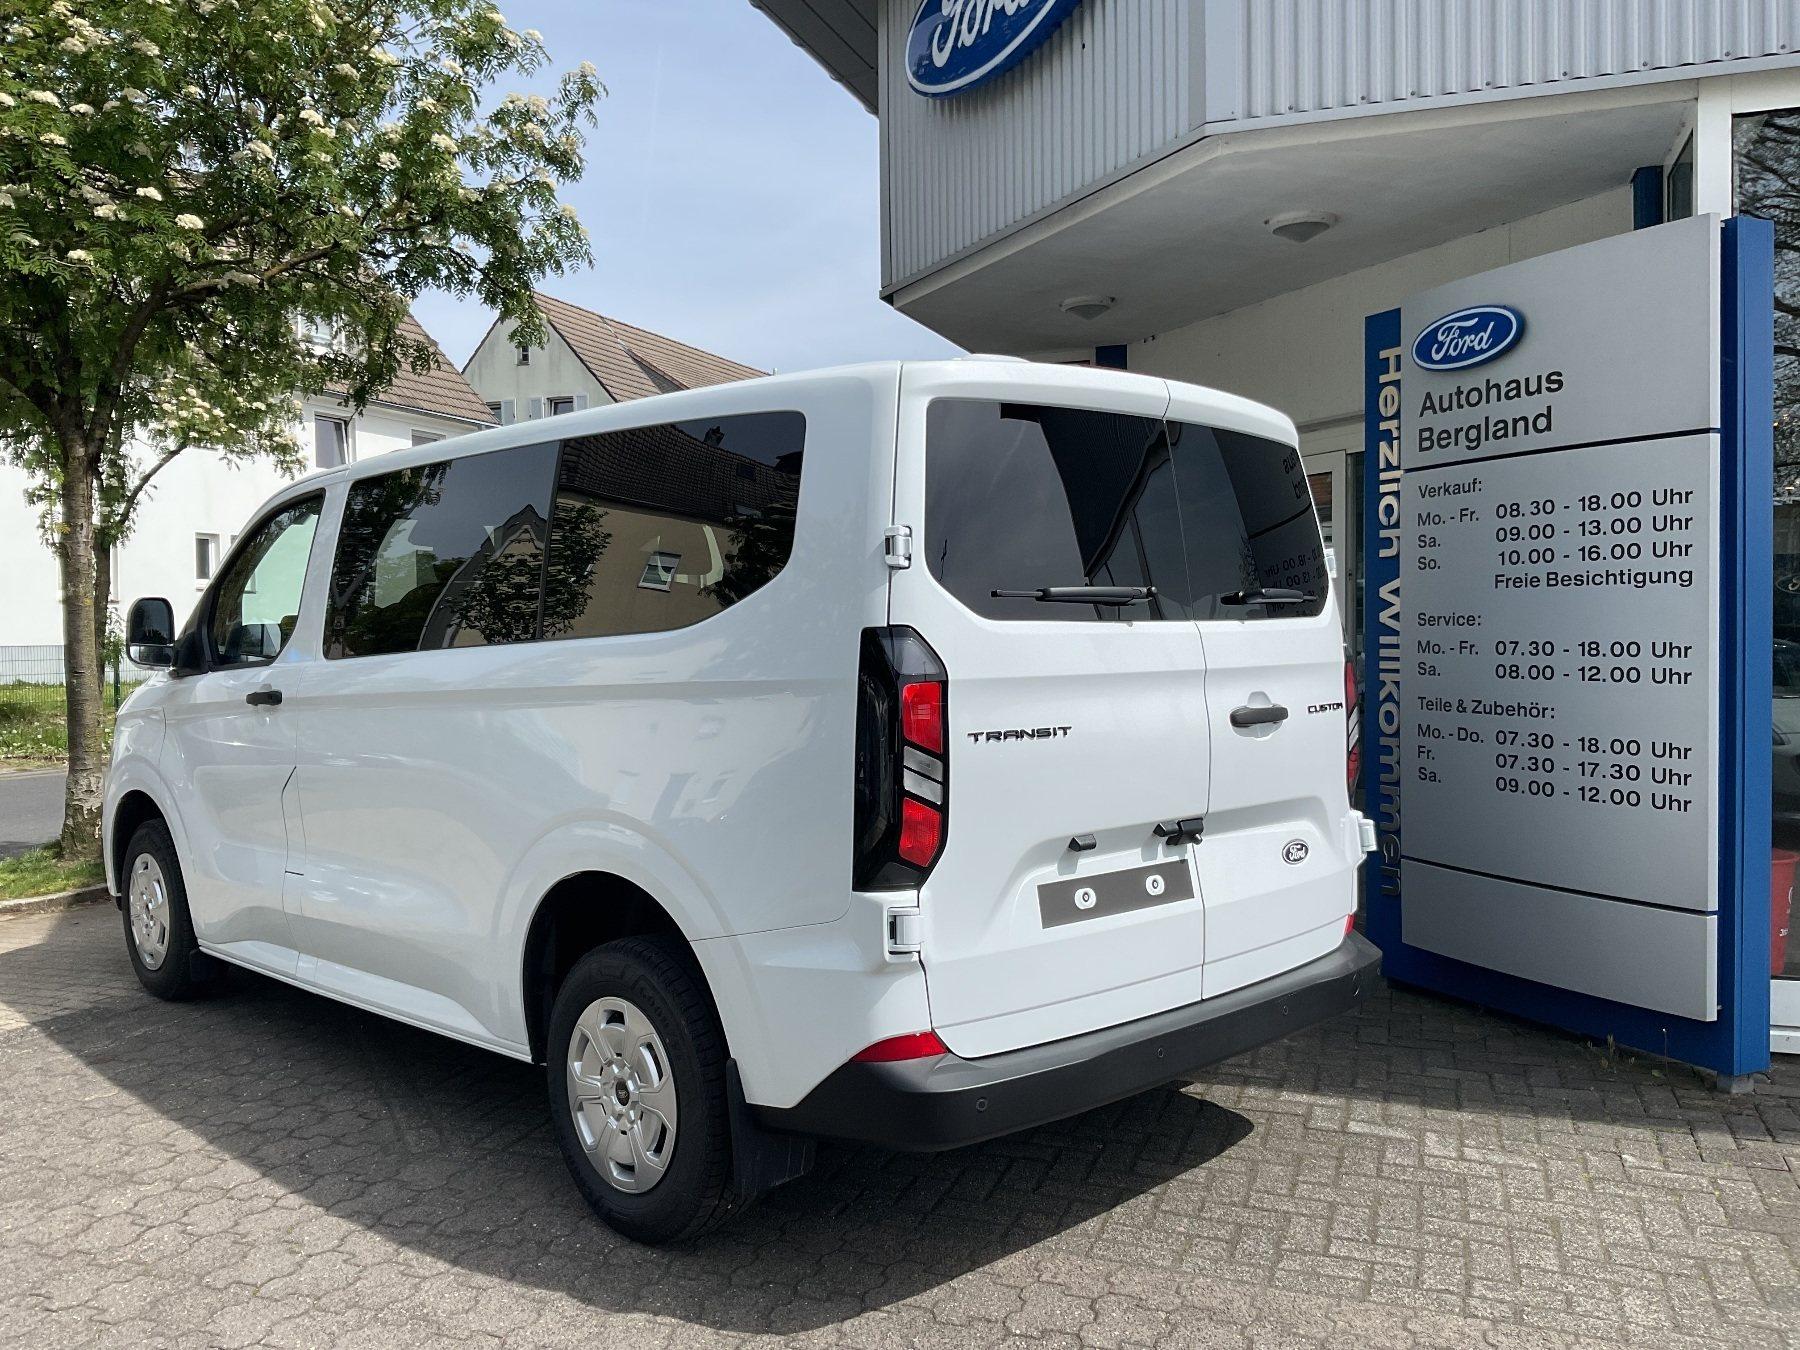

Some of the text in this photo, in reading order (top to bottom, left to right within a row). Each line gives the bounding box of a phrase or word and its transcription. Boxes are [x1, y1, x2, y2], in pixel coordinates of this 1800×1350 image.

[1431, 317, 1494, 361] Ford
[1419, 371, 1564, 417] Autohaus
[1418, 406, 1552, 452] Bergland
[1418, 478, 1481, 498] Verkauf:
[1418, 512, 1445, 526] Mo.
[1460, 508, 1479, 522] Fr.
[1496, 499, 1555, 519] 08.30
[1578, 491, 1641, 511] 18.00
[1653, 488, 1694, 506] Uhr
[1418, 534, 1440, 548] Sa.
[1496, 524, 1555, 542] 09.00
[1577, 517, 1641, 536] 13.00
[1653, 515, 1693, 532] Uhr
[1418, 556, 1440, 570] So.
[1498, 548, 1554, 566] 10.00
[1578, 543, 1641, 561] 16.00
[1653, 541, 1693, 558] Uhr
[1495, 568, 1692, 589] Freie Besichtigung
[1379, 346, 1404, 896] Herzlich Willkommen
[1418, 612, 1481, 626] Service:
[1418, 640, 1445, 654] Mo.
[1459, 641, 1478, 655] Fr.
[1495, 641, 1554, 656] 07.30
[1578, 641, 1641, 657] 18.00
[1652, 642, 1692, 658] Uhr
[1418, 662, 1440, 676] Sa.
[1495, 664, 1554, 680] 08.00
[1577, 666, 1640, 685] 12.00
[1652, 668, 1692, 684] Uhr
[1308, 702, 1343, 713] CUSTOM
[1418, 696, 1554, 720] Teile & Zubehör:
[967, 726, 1072, 744] TRANSIT
[1418, 724, 1446, 739] Mo.
[1457, 727, 1484, 743] Do.
[1496, 730, 1554, 751] 07.30
[1576, 737, 1640, 756] 18.00
[1652, 742, 1692, 759] Uhr
[1418, 745, 1435, 760] Fr.
[1496, 753, 1554, 775] 07.30
[1578, 761, 1640, 782] 17.30
[1652, 767, 1692, 786] Uhr
[1418, 767, 1441, 784] Sa.
[1496, 776, 1554, 798] 09.00
[1576, 785, 1640, 808] 12.00
[1652, 793, 1692, 812] Uhr
